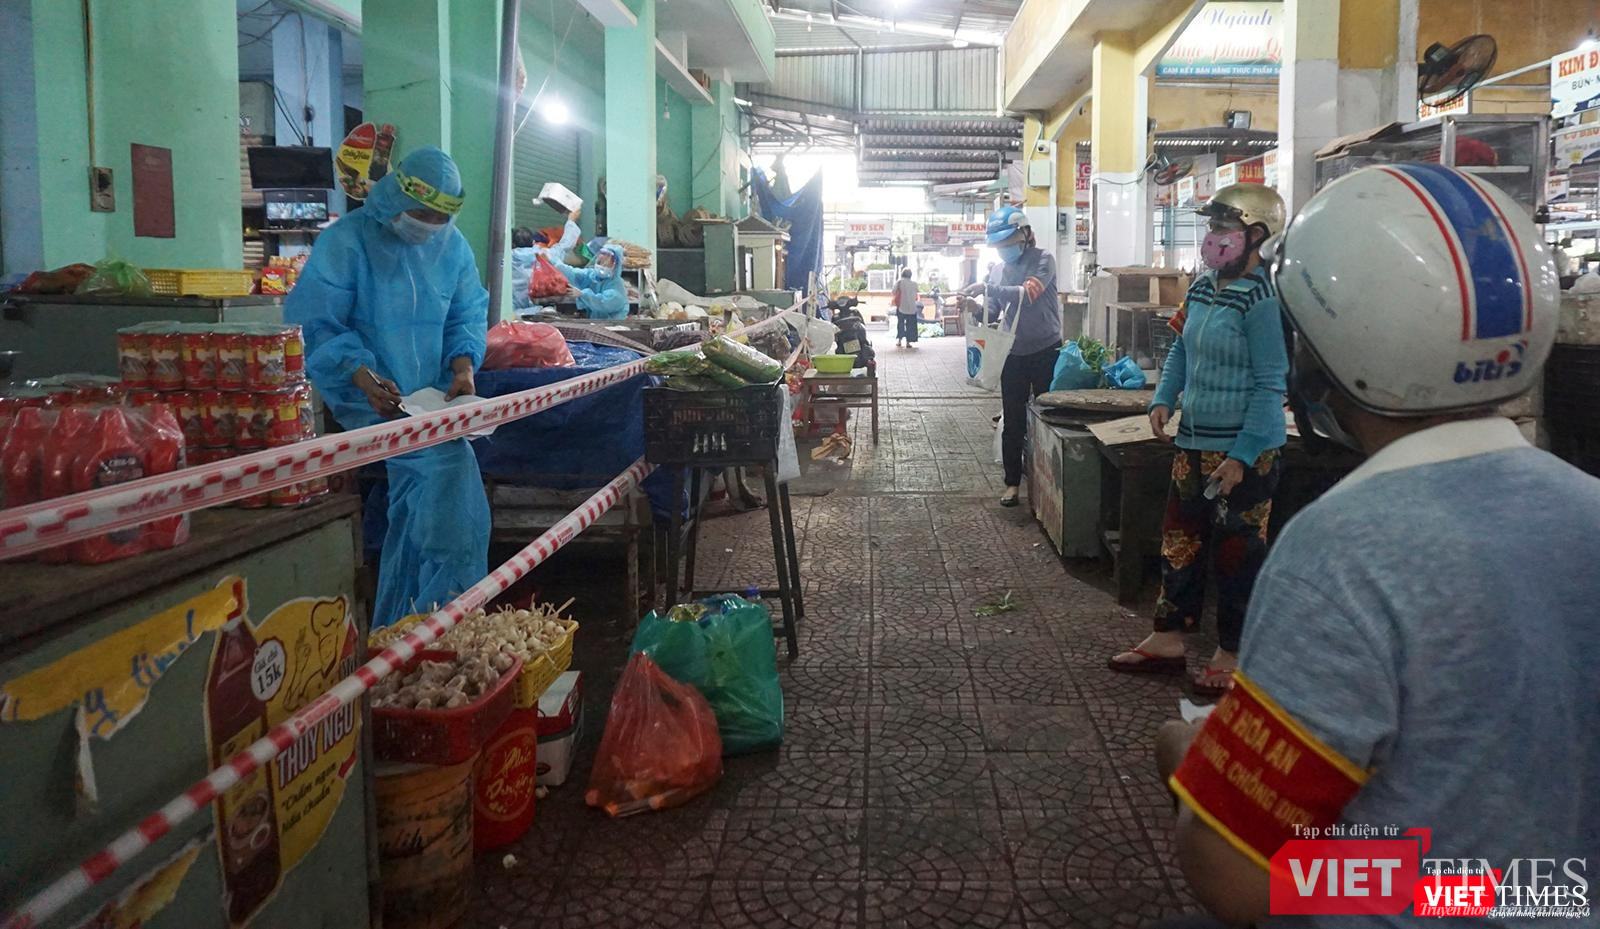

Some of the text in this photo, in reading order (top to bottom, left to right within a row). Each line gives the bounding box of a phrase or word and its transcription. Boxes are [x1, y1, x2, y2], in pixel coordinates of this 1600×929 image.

[1559, 54, 1584, 78] KIM
[258, 663, 281, 694] 15k
[1264, 739, 1302, 775] AN
